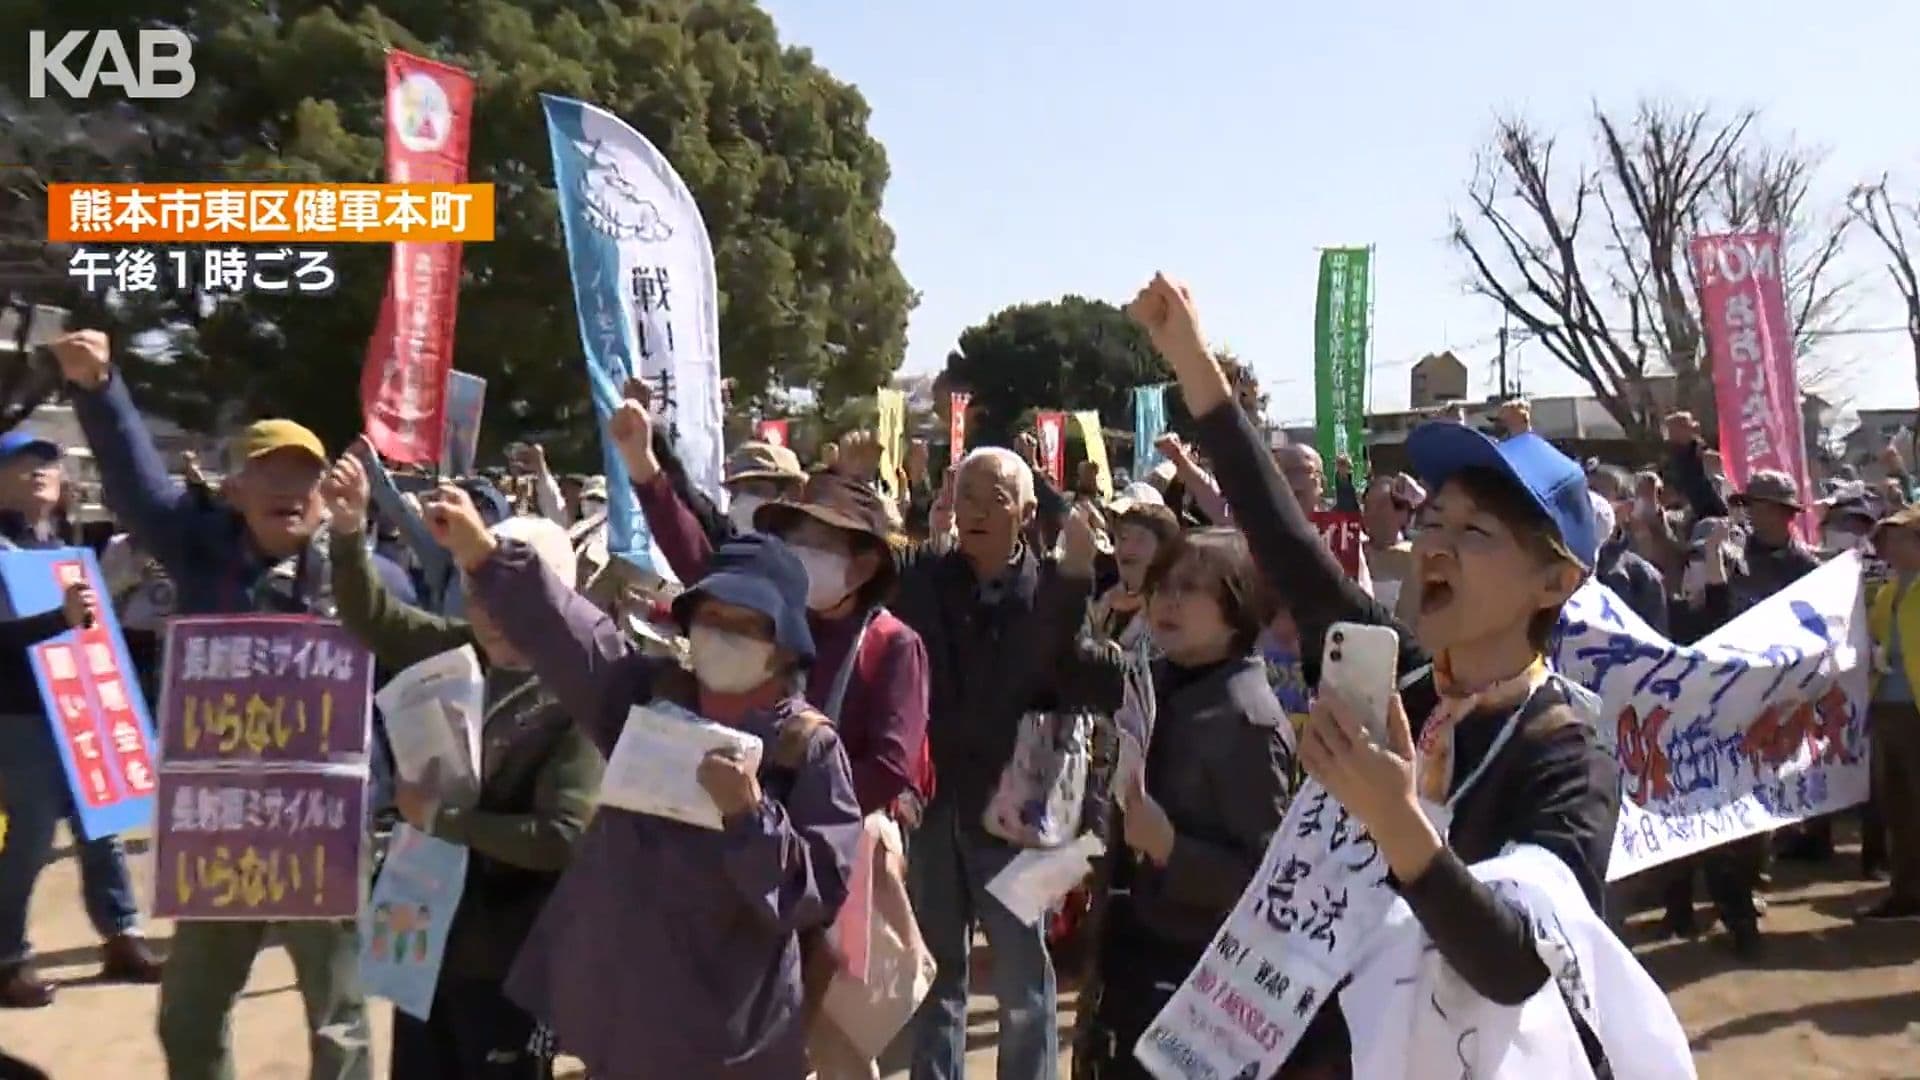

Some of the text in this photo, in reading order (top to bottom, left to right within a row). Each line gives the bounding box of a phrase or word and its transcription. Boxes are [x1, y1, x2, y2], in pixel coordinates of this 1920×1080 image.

[184, 690, 333, 753] いらない！
[176, 846, 325, 906] いらない！
